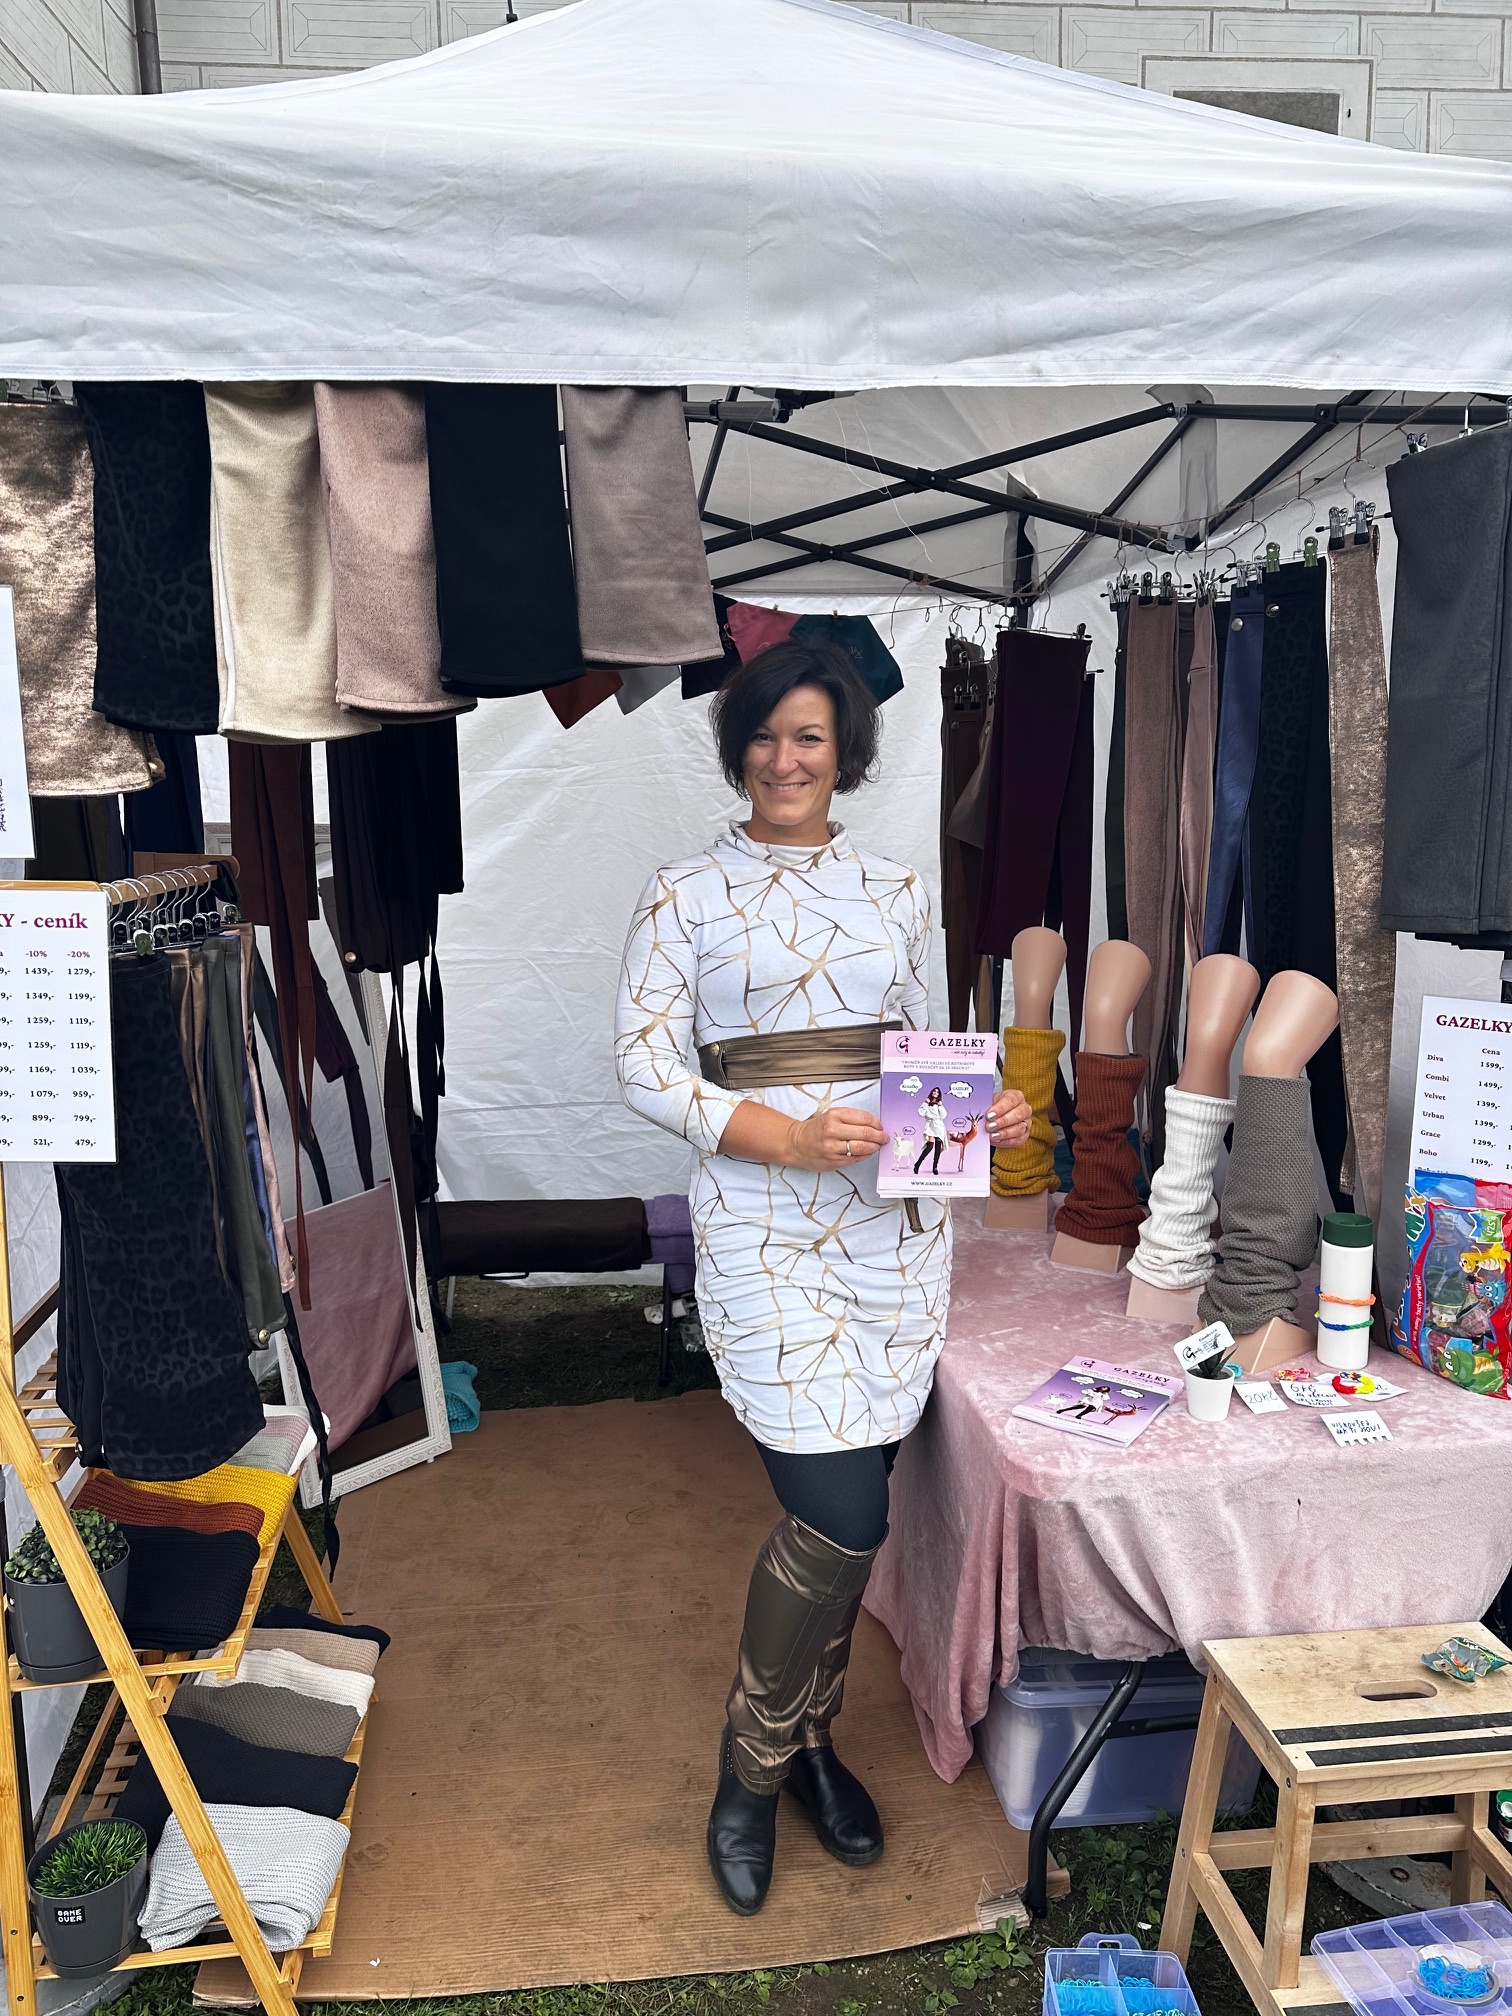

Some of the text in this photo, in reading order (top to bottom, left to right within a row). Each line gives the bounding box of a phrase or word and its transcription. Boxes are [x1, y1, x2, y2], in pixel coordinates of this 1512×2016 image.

[34, 912, 88, 928] ceník
[1436, 1014, 1512, 1034] GAZELKY
[930, 1038, 986, 1048] GAZELKY
[1425, 1073, 1449, 1082] Combi
[72, 1090, 94, 1099] 959,-
[1424, 1092, 1446, 1100] Velvet
[32, 1114, 55, 1123] 899,-
[74, 1115, 96, 1123] 799,-
[1422, 1111, 1445, 1120] Urban
[1420, 1129, 1441, 1138] Grace
[33, 1139, 53, 1147] 521,-
[75, 1139, 96, 1147] 479,-
[1419, 1148, 1438, 1157] Boho
[1114, 1367, 1170, 1383] GAZELKY
